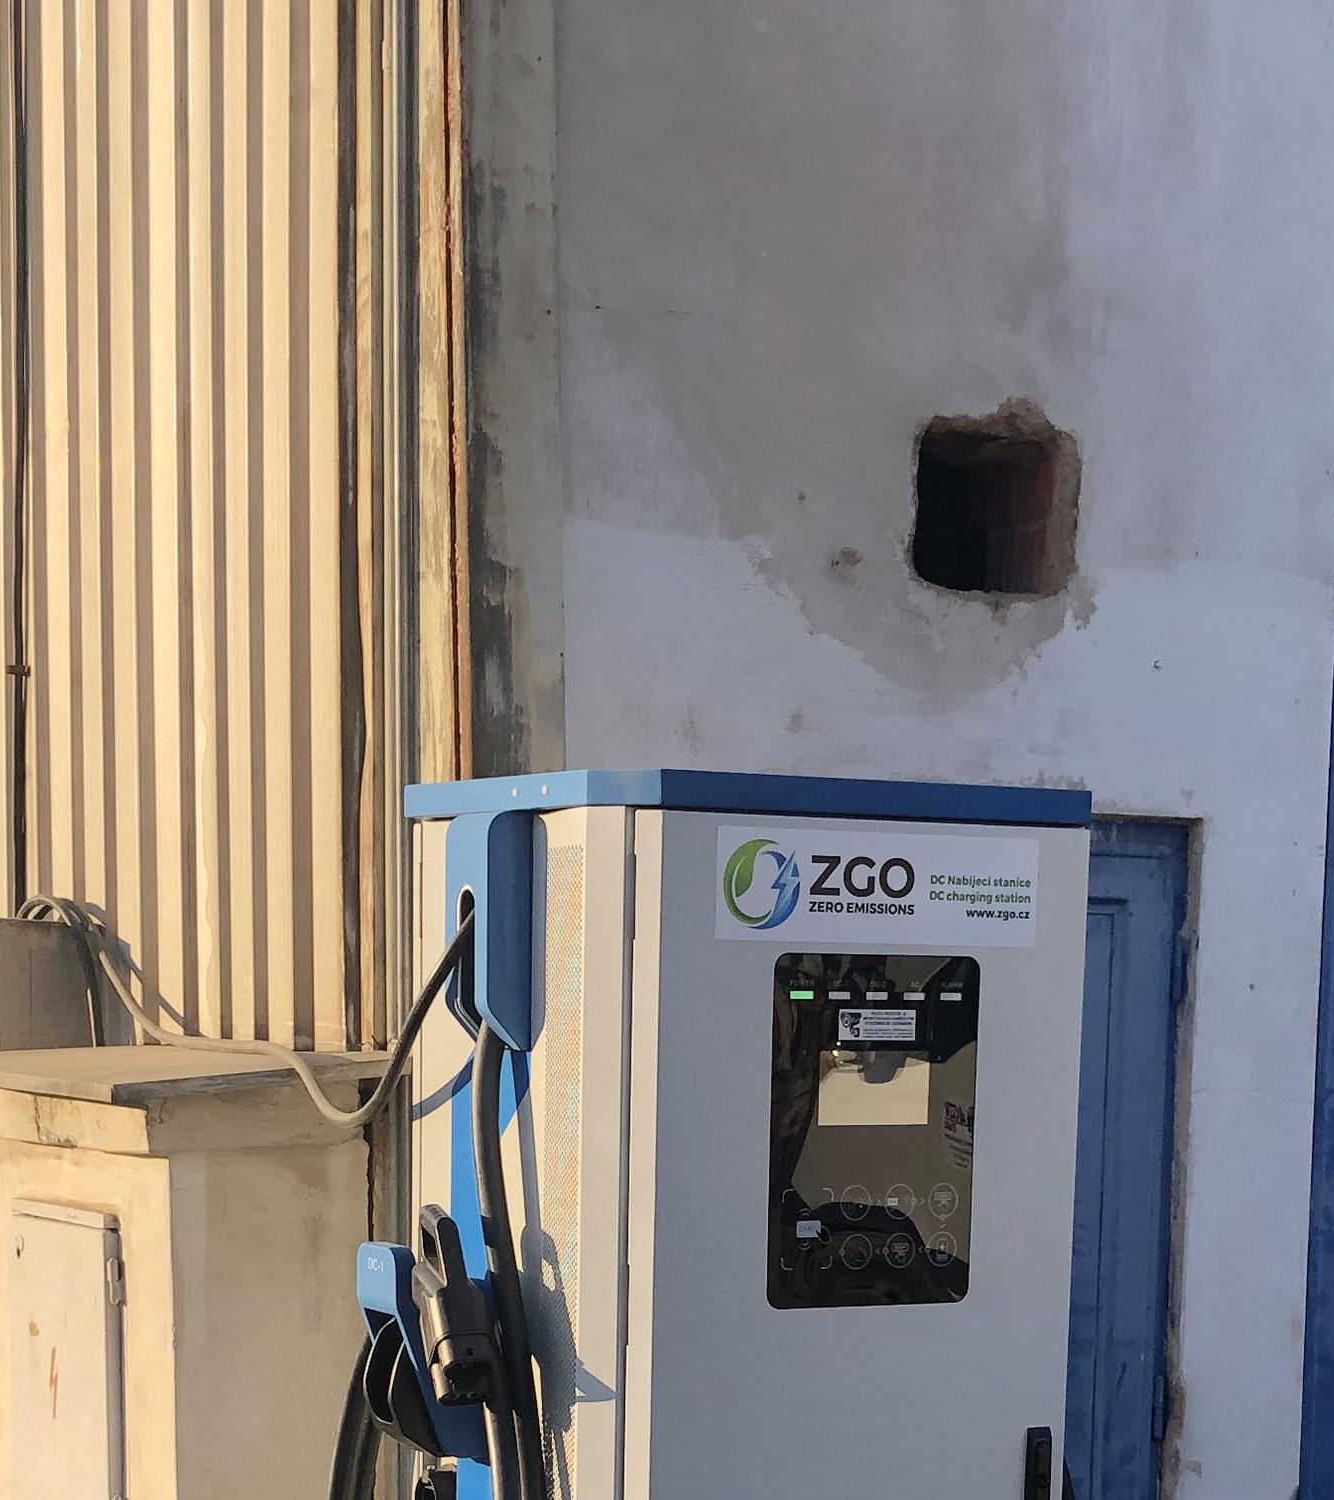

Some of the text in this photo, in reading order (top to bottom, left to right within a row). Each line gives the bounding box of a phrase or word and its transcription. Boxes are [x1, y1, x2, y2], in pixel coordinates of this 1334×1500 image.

[810, 855, 915, 898] ZGO
[930, 875, 945, 885] DC
[993, 877, 1031, 888] stanice
[929, 890, 1031, 904] DC charging station
[809, 901, 915, 915] ZERO EMISSIONS
[965, 910, 1031, 921] www.zgo.cz
[367, 1257, 384, 1272] DC-1
